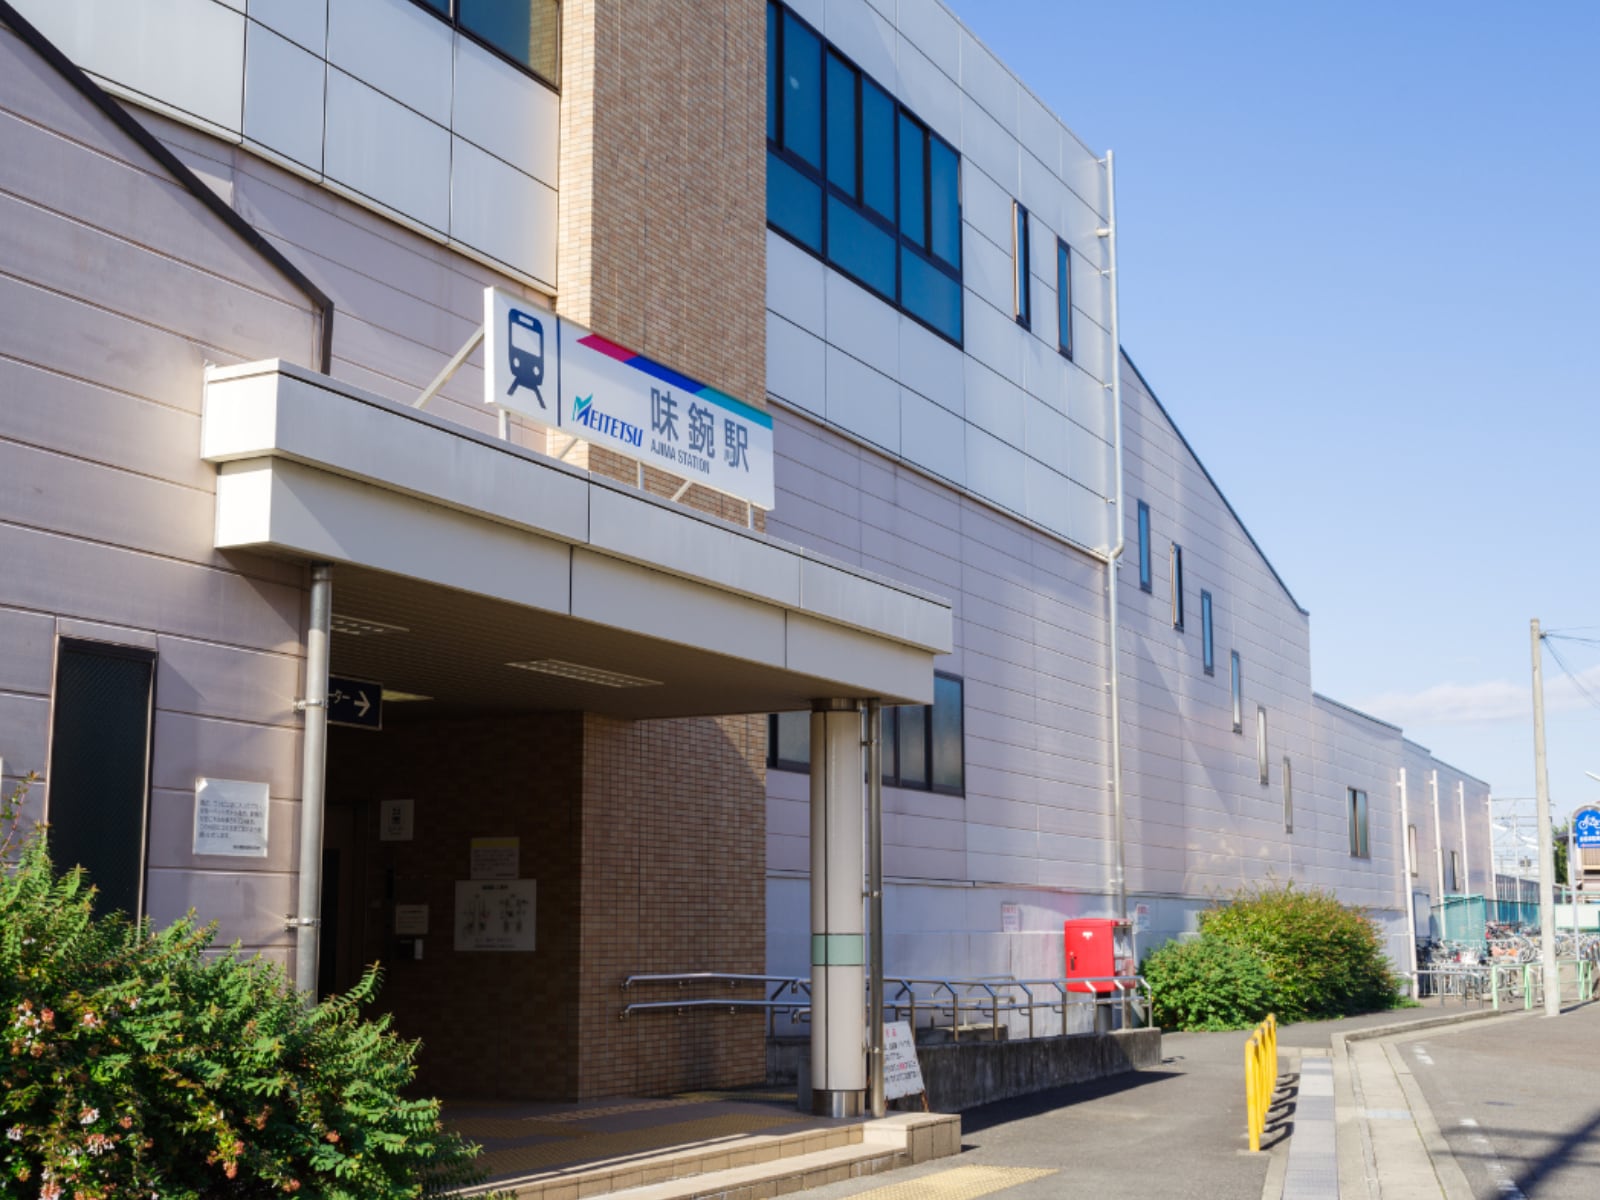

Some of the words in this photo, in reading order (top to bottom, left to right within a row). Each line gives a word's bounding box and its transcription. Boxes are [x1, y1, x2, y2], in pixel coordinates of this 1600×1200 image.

[572, 392, 643, 447] MEITETSU
[650, 386, 749, 472] 味鋺駅
[677, 449, 710, 474] STATION
